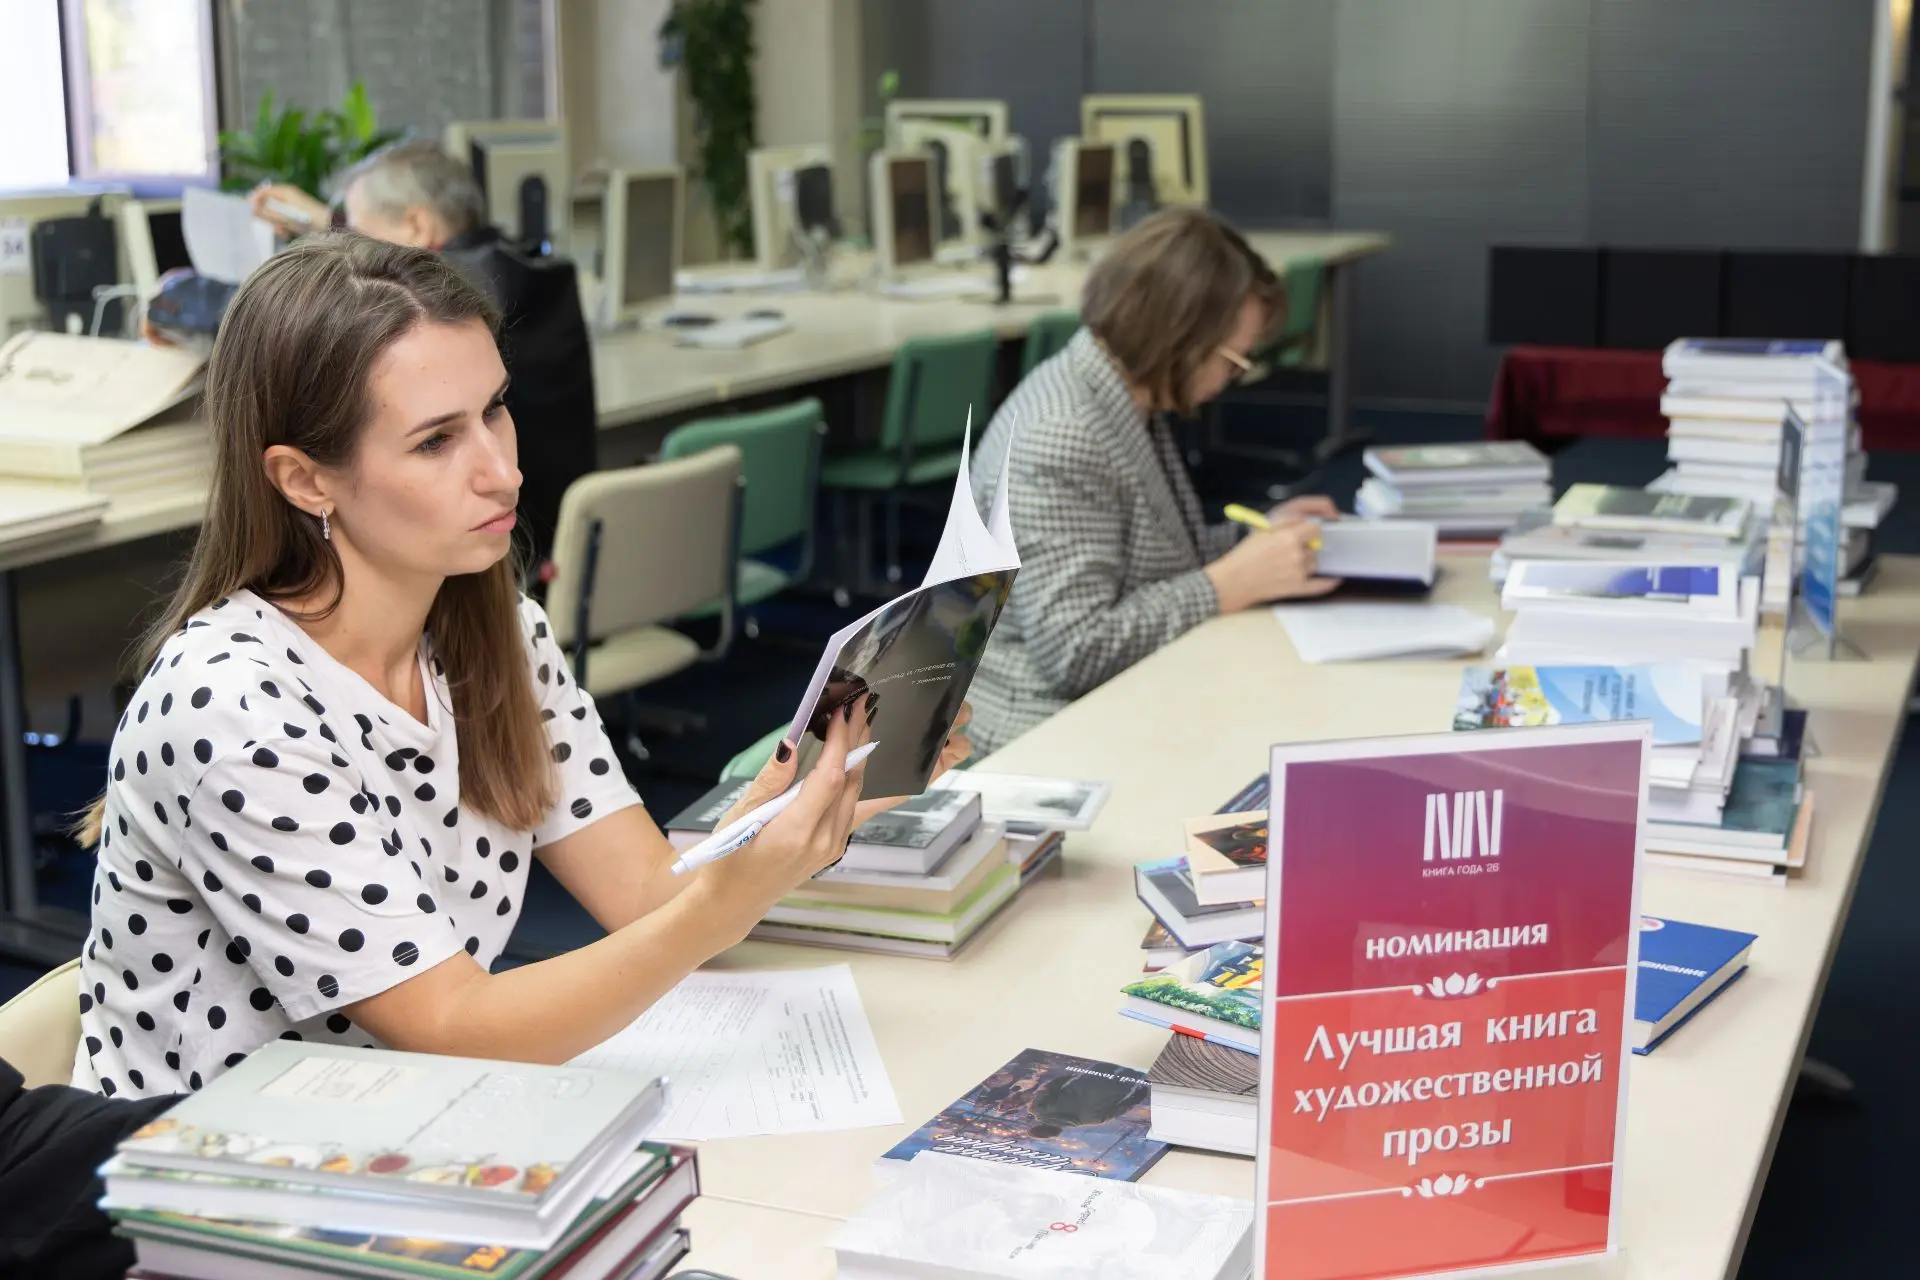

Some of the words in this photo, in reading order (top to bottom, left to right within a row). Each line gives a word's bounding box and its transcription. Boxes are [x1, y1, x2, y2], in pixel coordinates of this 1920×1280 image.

[1422, 866, 1455, 878] КНИГА
[1456, 864, 1483, 876] ГОДА
[1366, 923, 1549, 960] номинация
[1303, 1020, 1463, 1071] Лучшая
[1486, 1007, 1599, 1045] книга
[1293, 1053, 1604, 1122] художественной
[1382, 1118, 1513, 1166] прозы
